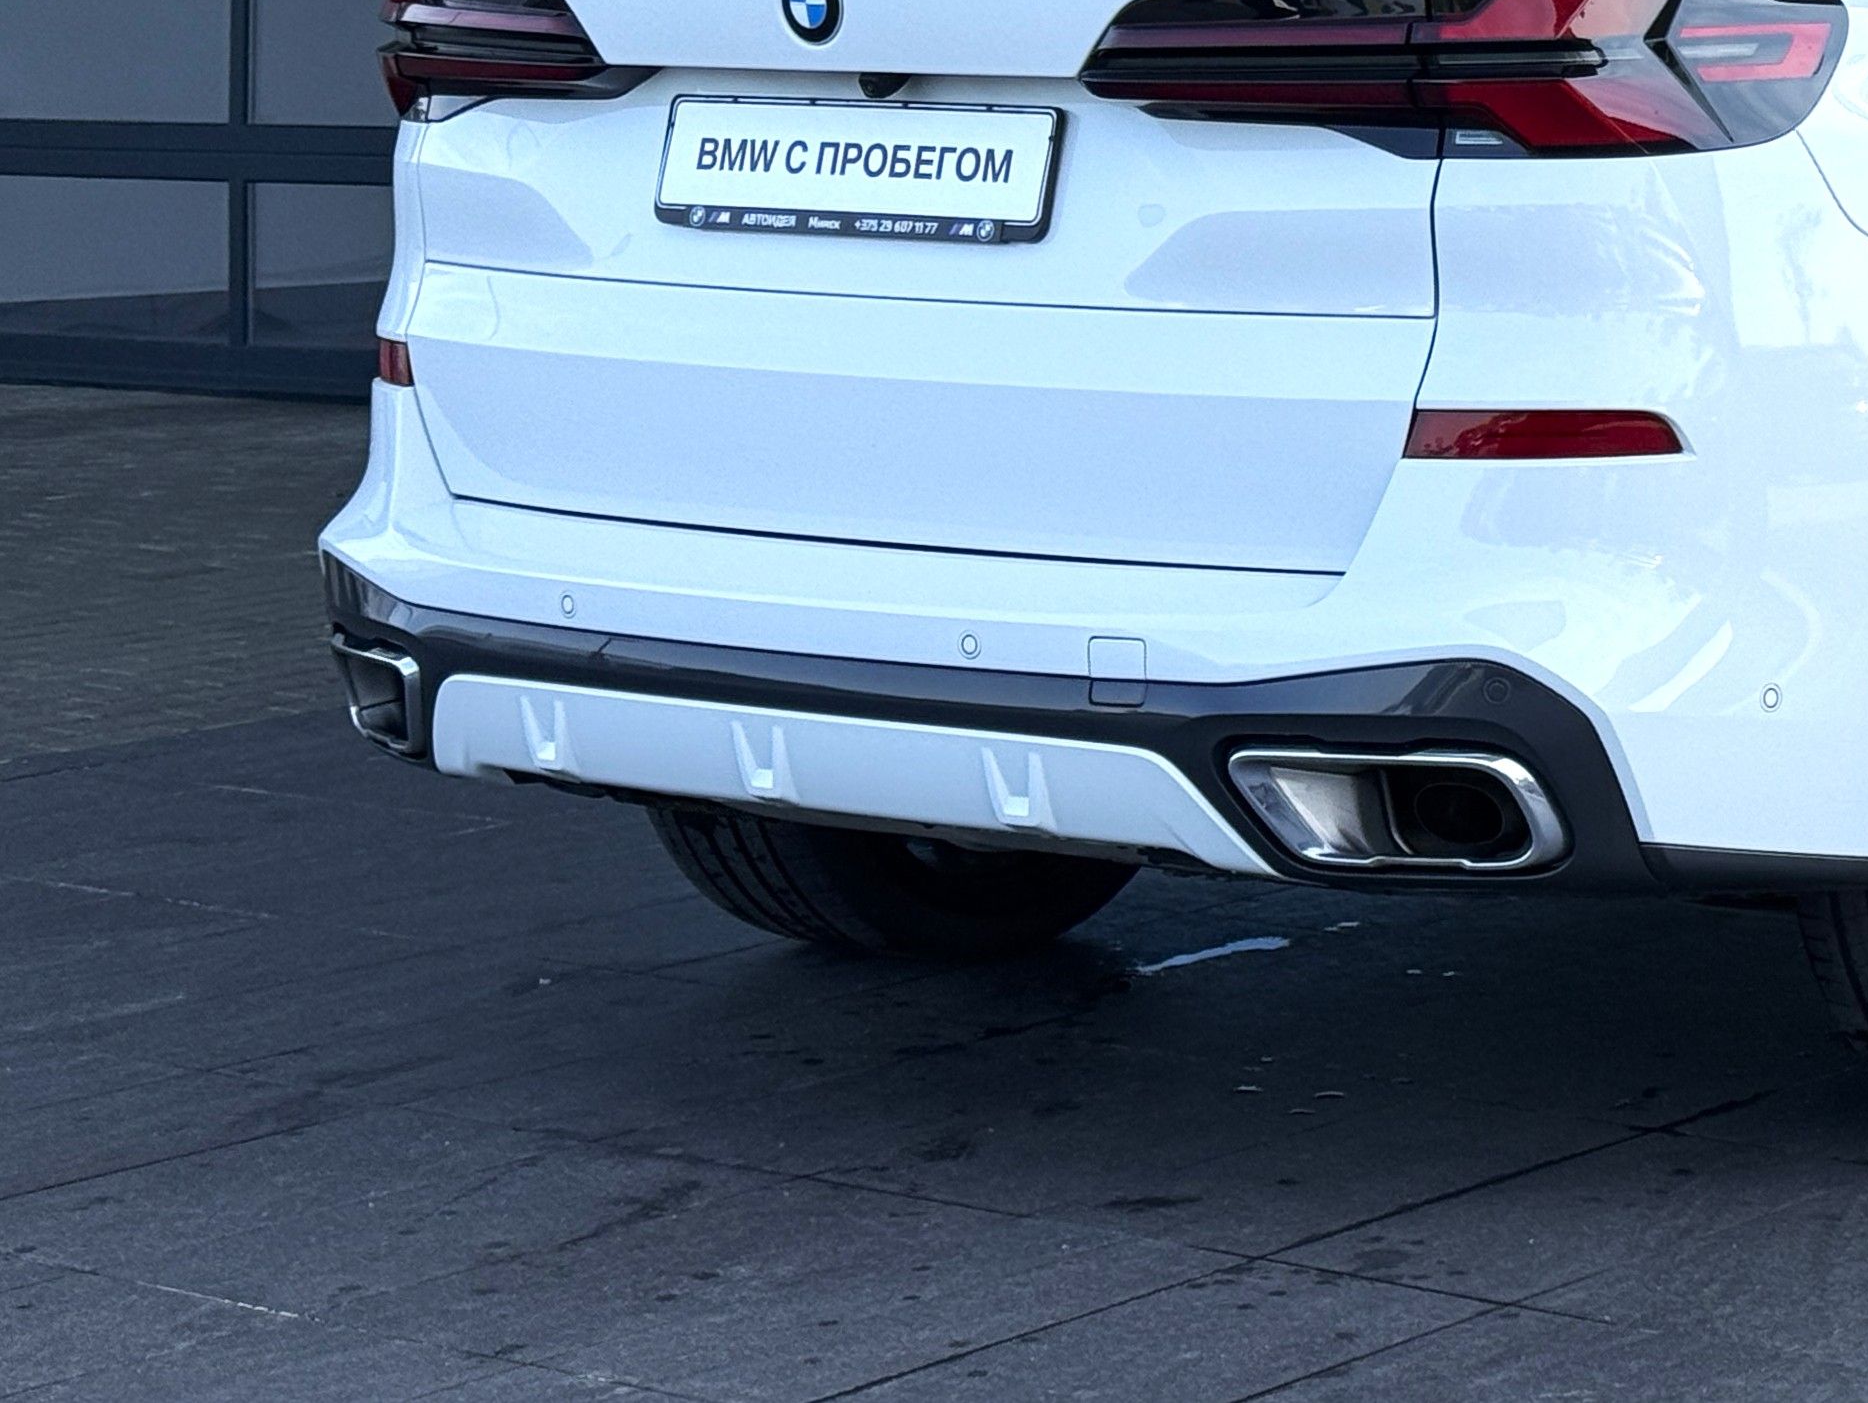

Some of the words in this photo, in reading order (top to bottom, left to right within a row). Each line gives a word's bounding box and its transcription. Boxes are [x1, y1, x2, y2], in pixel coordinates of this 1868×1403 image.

[696, 137, 780, 172] BMW
[785, 140, 808, 174] С
[815, 141, 1014, 183] ПРОБЕГОМ
[741, 213, 797, 228] АВТОИДЕЯ
